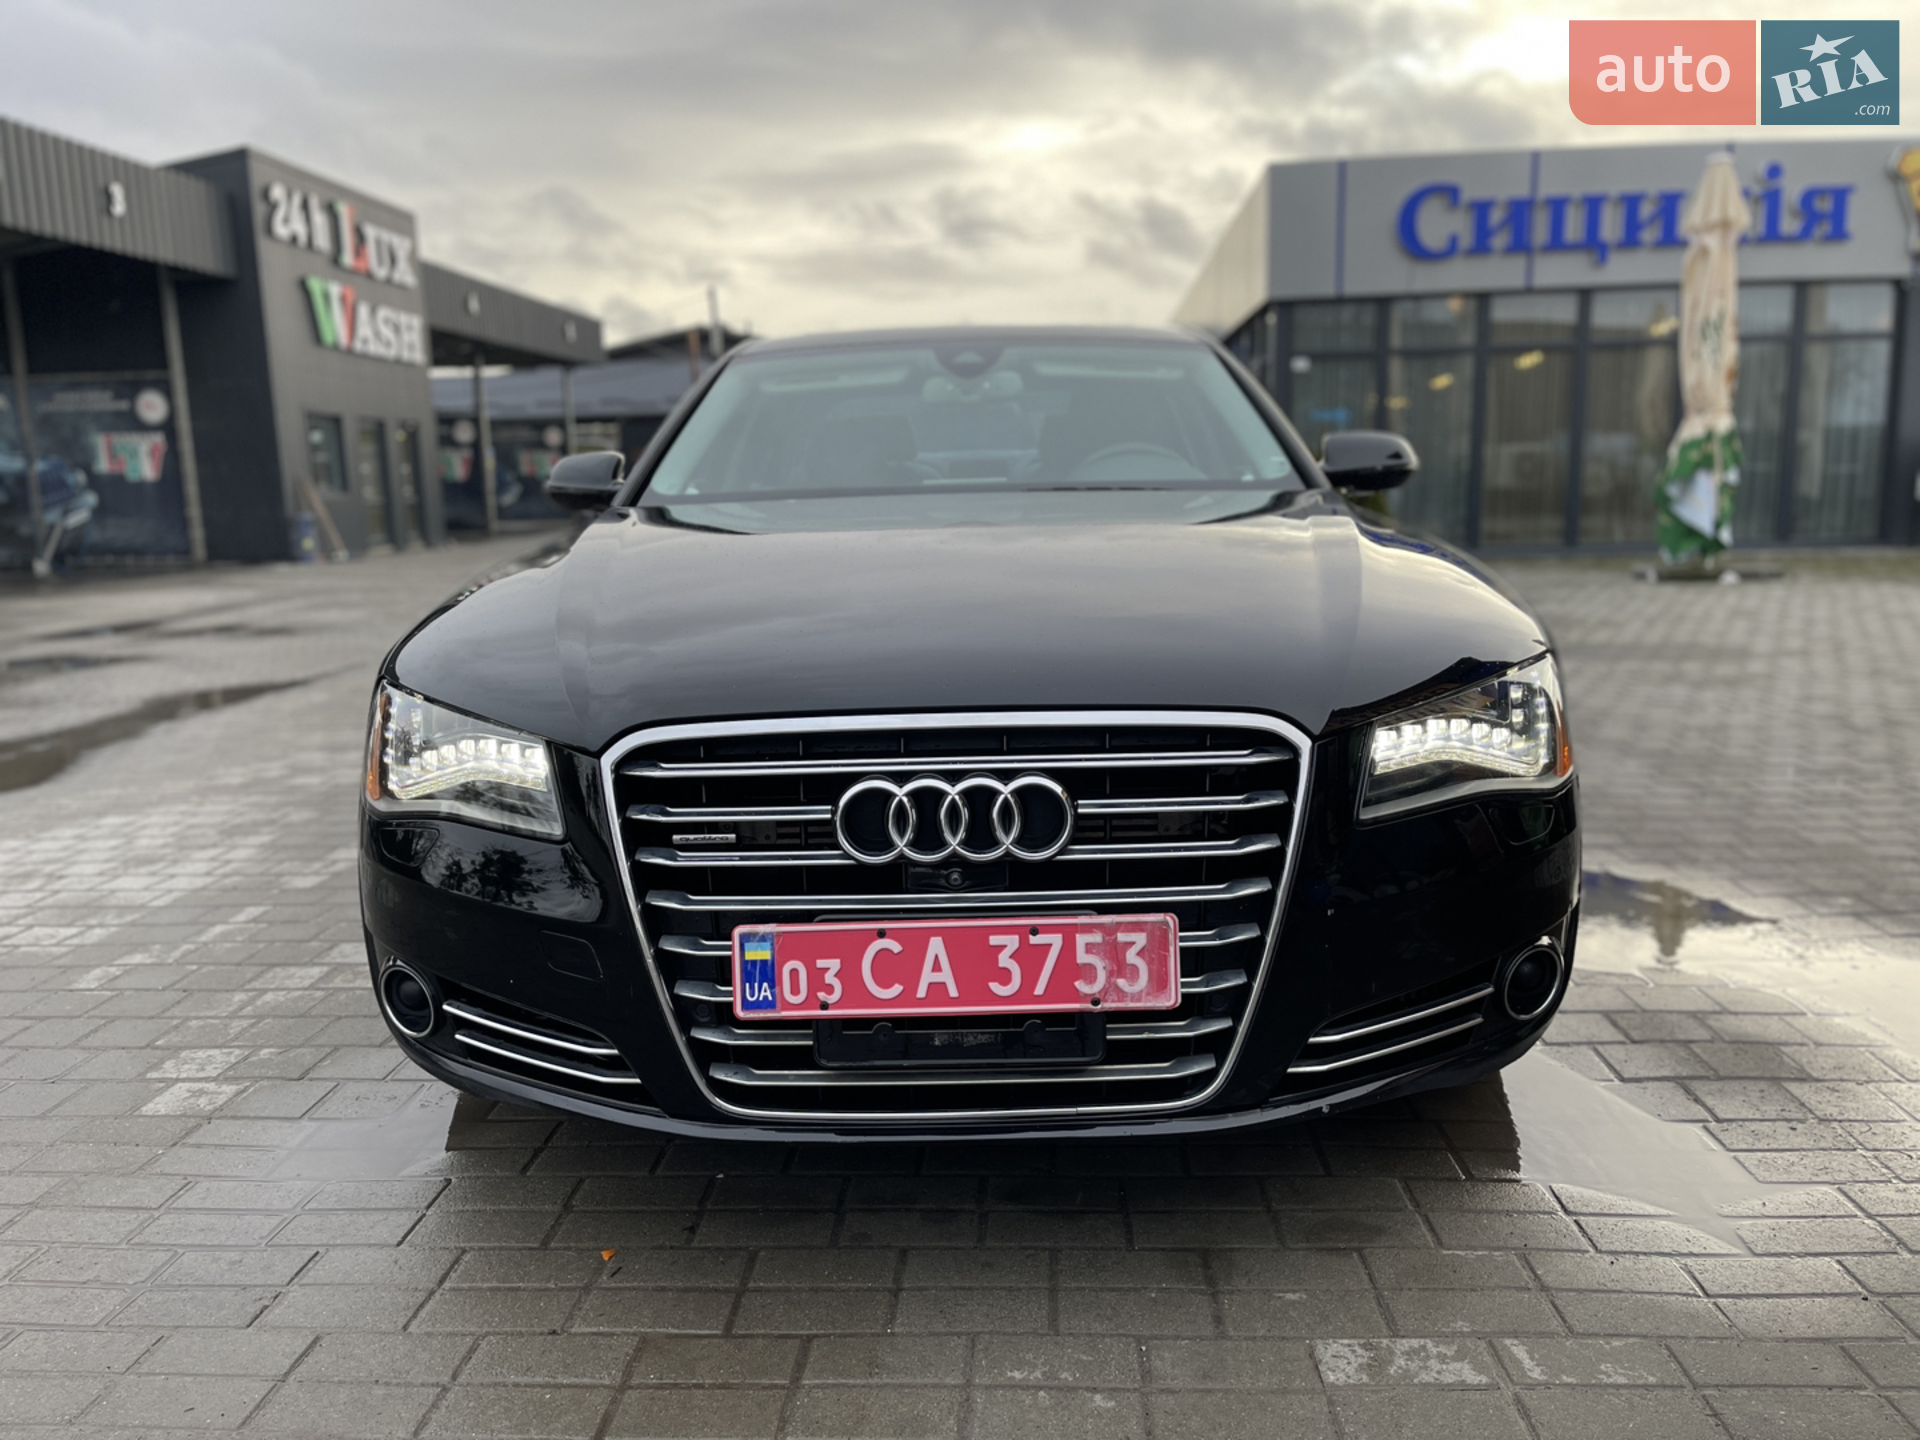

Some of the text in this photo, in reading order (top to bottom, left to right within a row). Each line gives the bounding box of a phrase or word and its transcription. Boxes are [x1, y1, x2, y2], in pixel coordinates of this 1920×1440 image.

[334, 202, 417, 289] LUX
[1396, 162, 1855, 267] Сициія
[305, 276, 426, 366] WASH
[745, 981, 773, 1002] UA
[781, 957, 843, 1006] 03
[987, 931, 1150, 996] 3753
